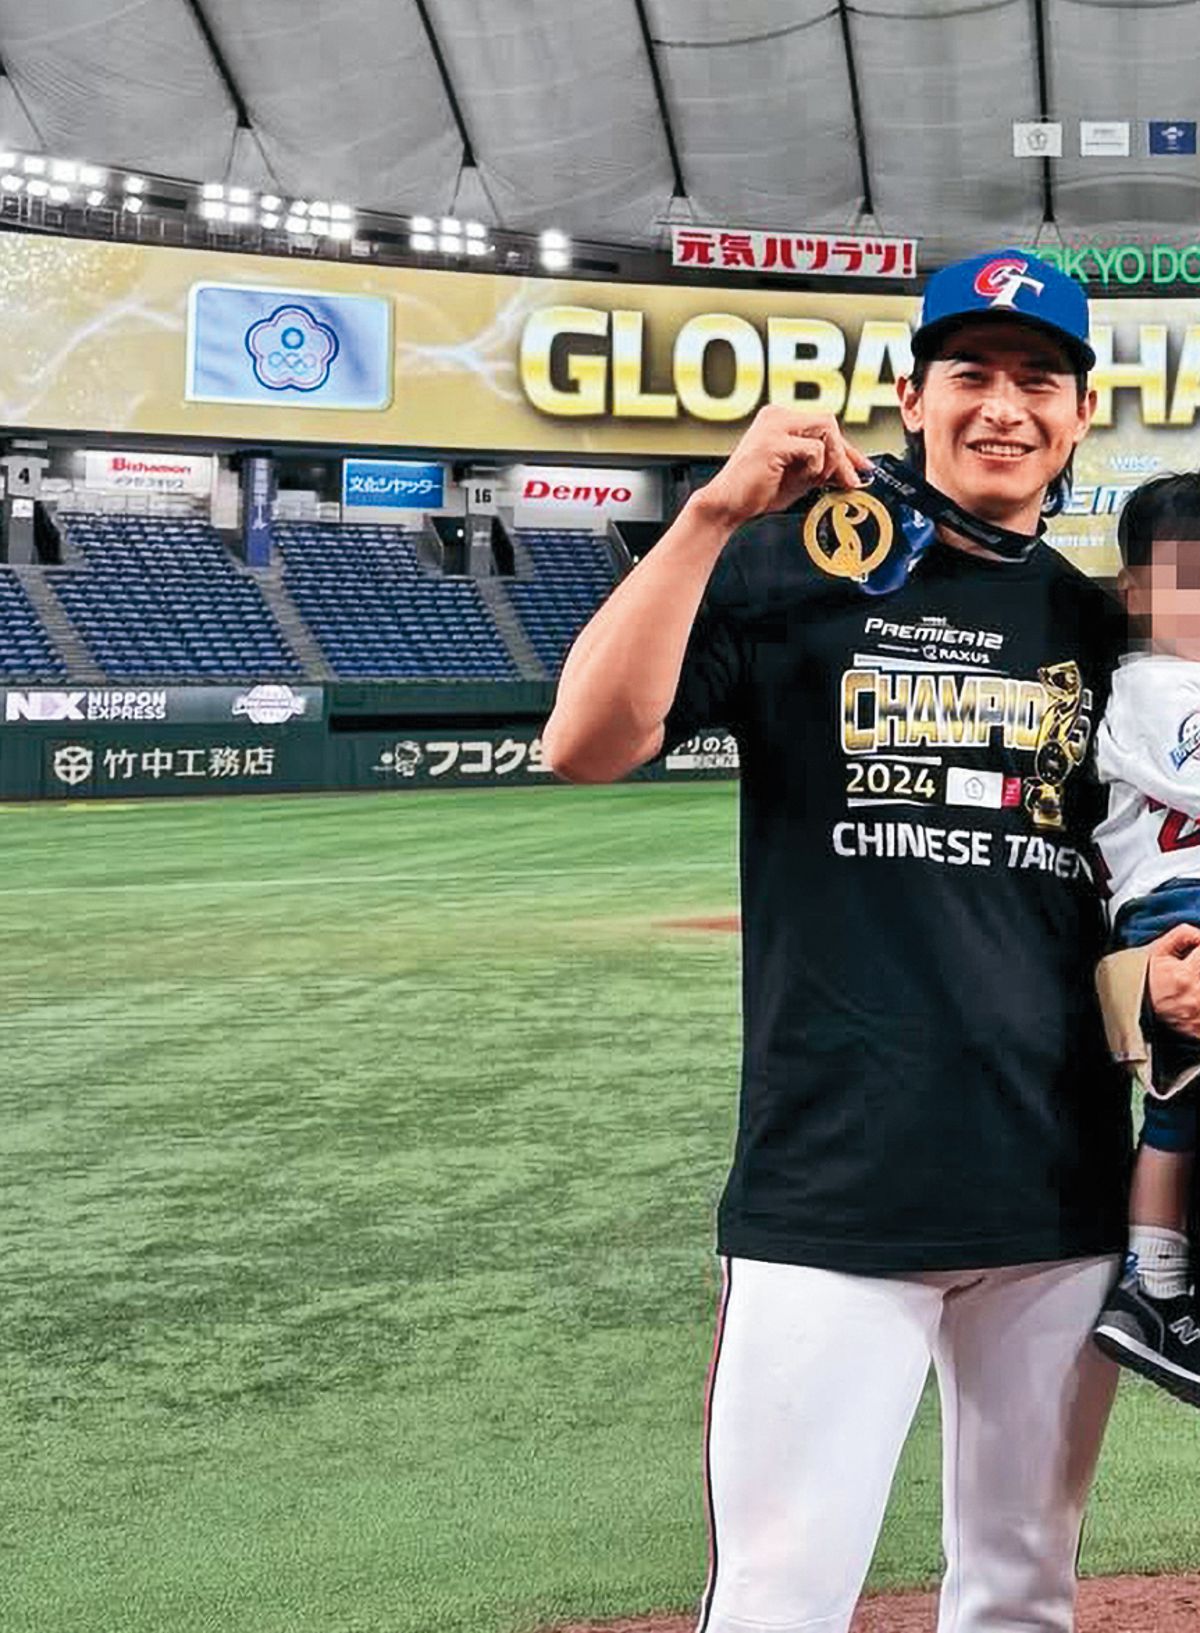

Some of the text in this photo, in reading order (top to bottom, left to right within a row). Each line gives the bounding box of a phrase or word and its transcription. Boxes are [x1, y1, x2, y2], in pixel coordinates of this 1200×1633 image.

[677, 231, 913, 275] 元気ハツラツ!
[1022, 246, 1146, 285] KYO
[519, 308, 914, 424] GLOBA
[18, 467, 30, 485] 4
[523, 479, 632, 507] Denyo
[474, 489, 491, 504] 16
[87, 705, 166, 720] EXPRESS
[88, 691, 166, 706] NIPPON
[841, 667, 1092, 765] CHAMPIO
[103, 746, 277, 780] 竹中工務店
[846, 763, 936, 798] 2024
[832, 821, 992, 867] CHINESE
